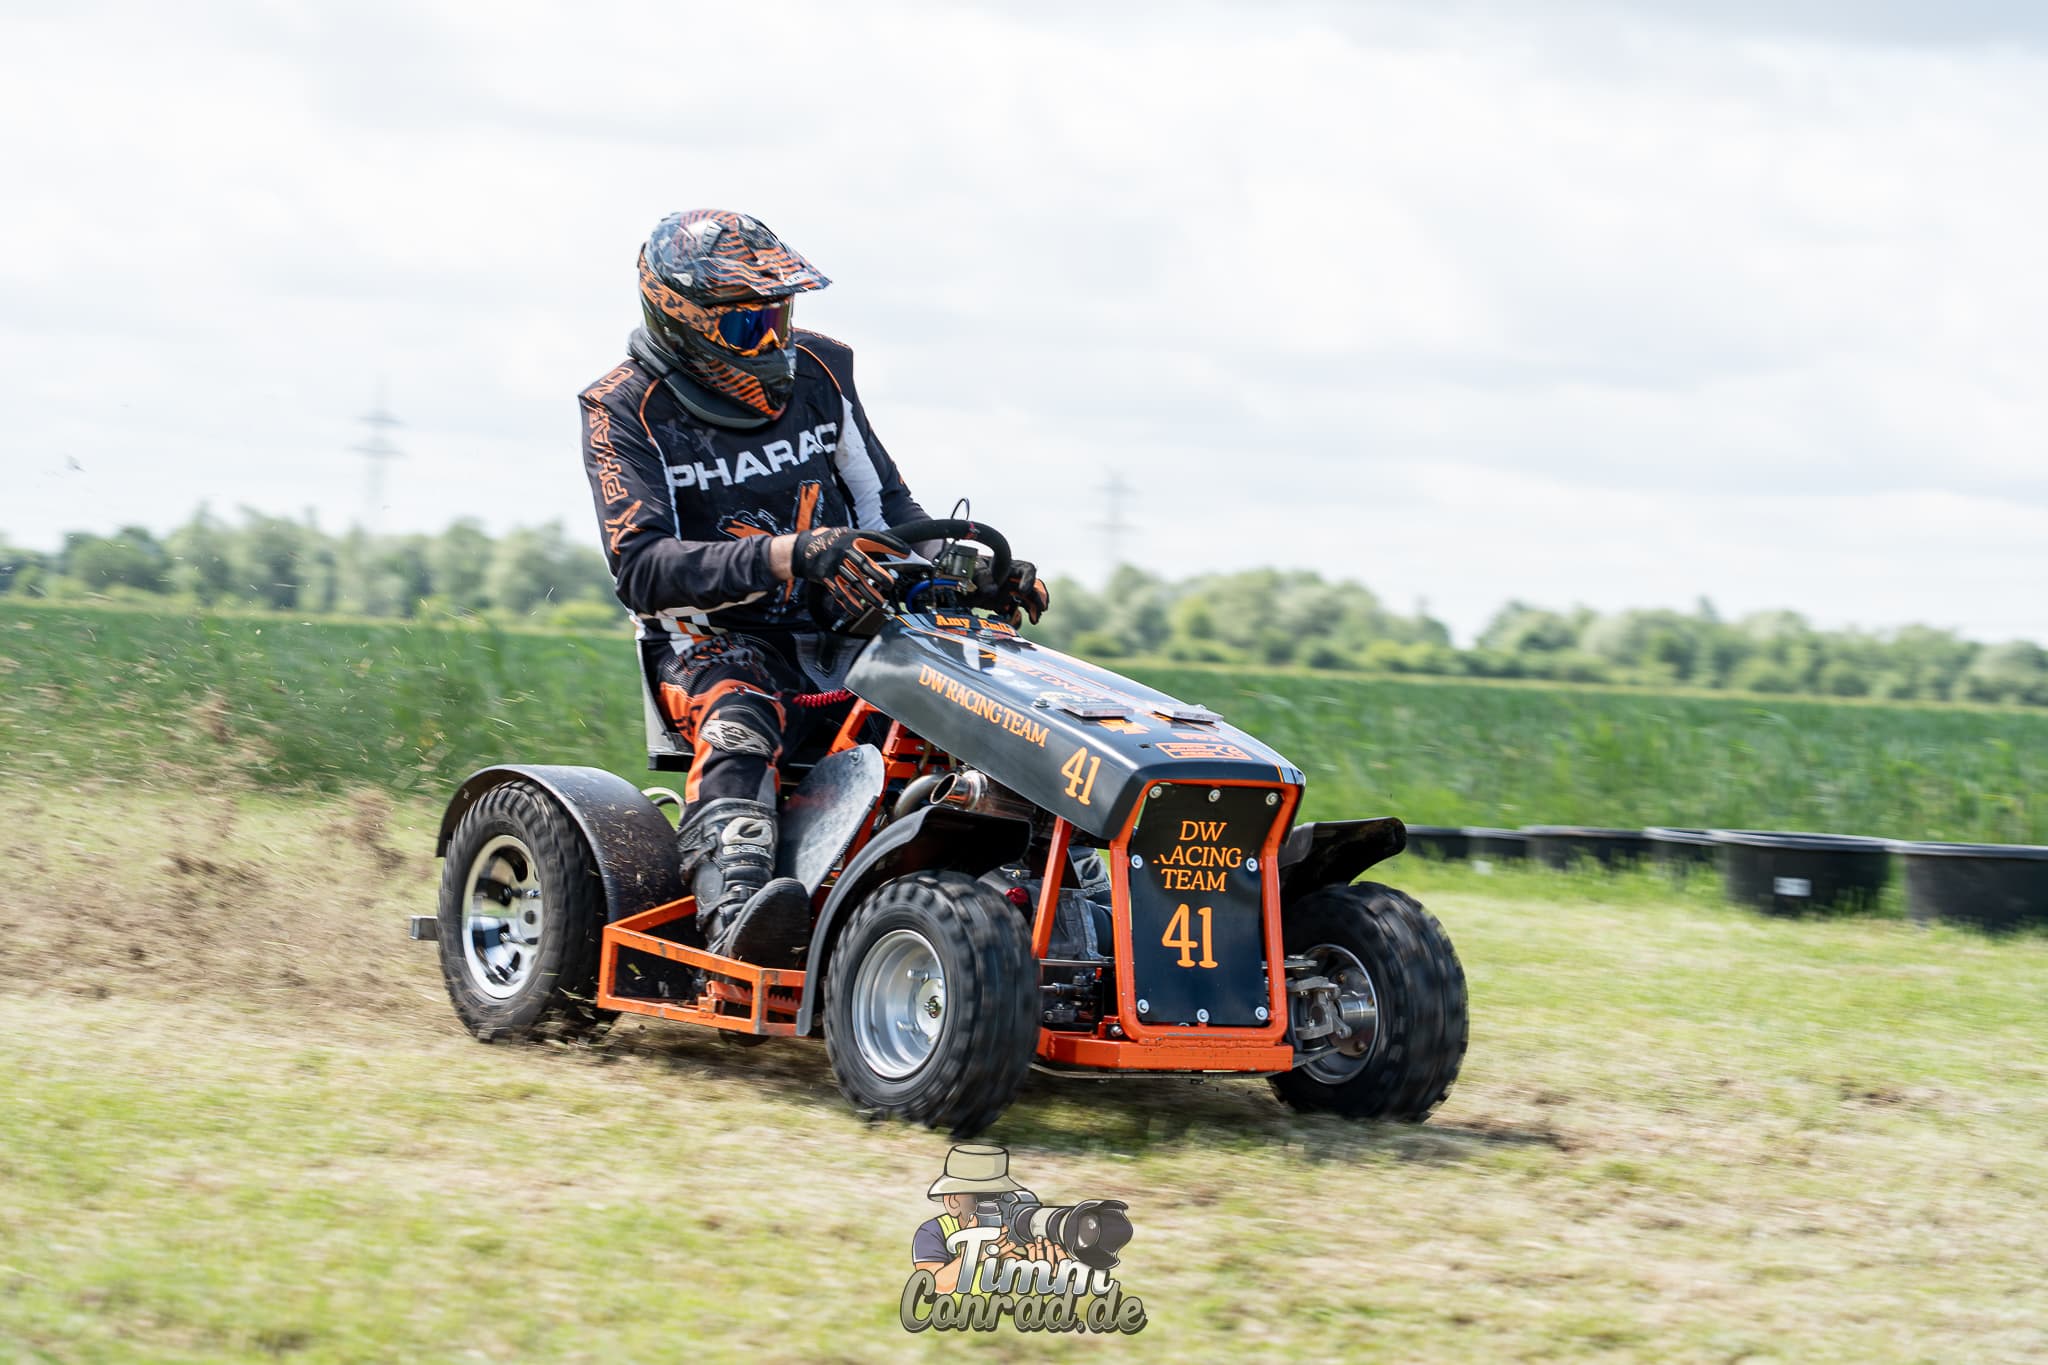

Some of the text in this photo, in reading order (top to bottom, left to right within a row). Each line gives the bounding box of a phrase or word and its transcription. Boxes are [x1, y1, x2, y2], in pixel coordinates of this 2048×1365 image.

[935, 614, 970, 629] Amy
[918, 664, 946, 694] DW
[944, 680, 1002, 725] RACING
[1001, 707, 1050, 748] TEAM
[1061, 746, 1102, 806] 41
[1179, 820, 1227, 842] DW
[1153, 845, 1242, 869] ACING
[1161, 868, 1227, 892] TEAM
[1161, 903, 1219, 969] 41
